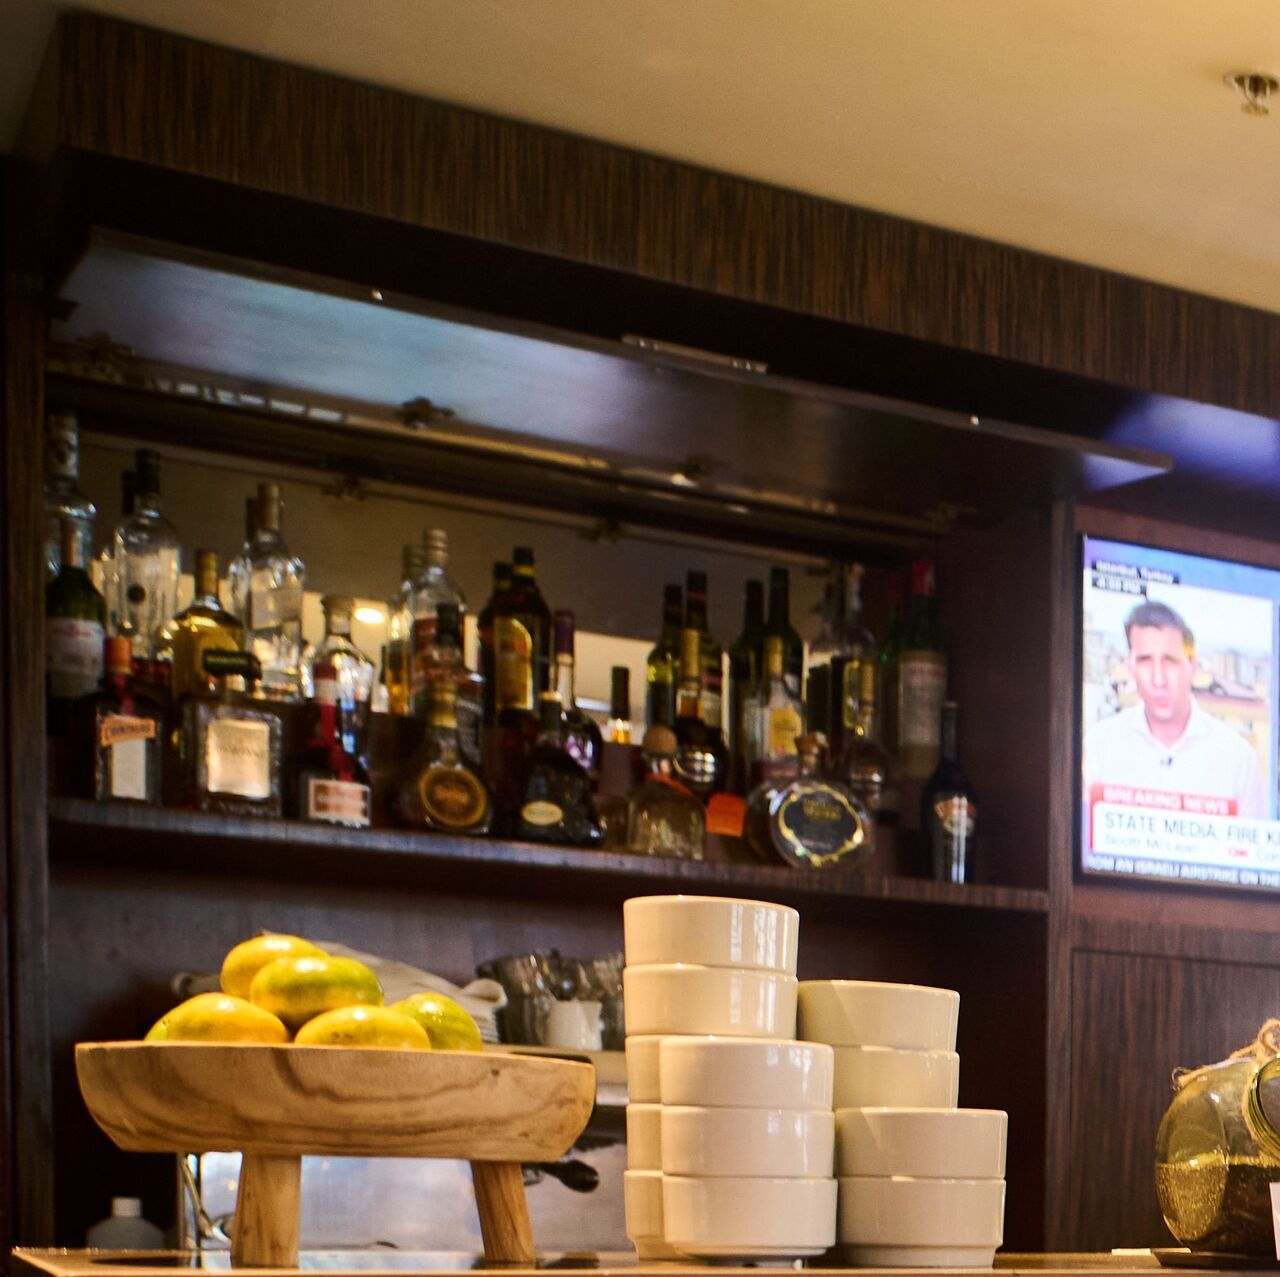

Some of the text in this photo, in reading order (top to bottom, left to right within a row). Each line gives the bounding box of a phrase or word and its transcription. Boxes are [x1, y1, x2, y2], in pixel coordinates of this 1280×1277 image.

[1103, 786, 1228, 815] BREAKING NEWS
[1105, 813, 1157, 833] STATE
[1228, 825, 1260, 844] FIRE
